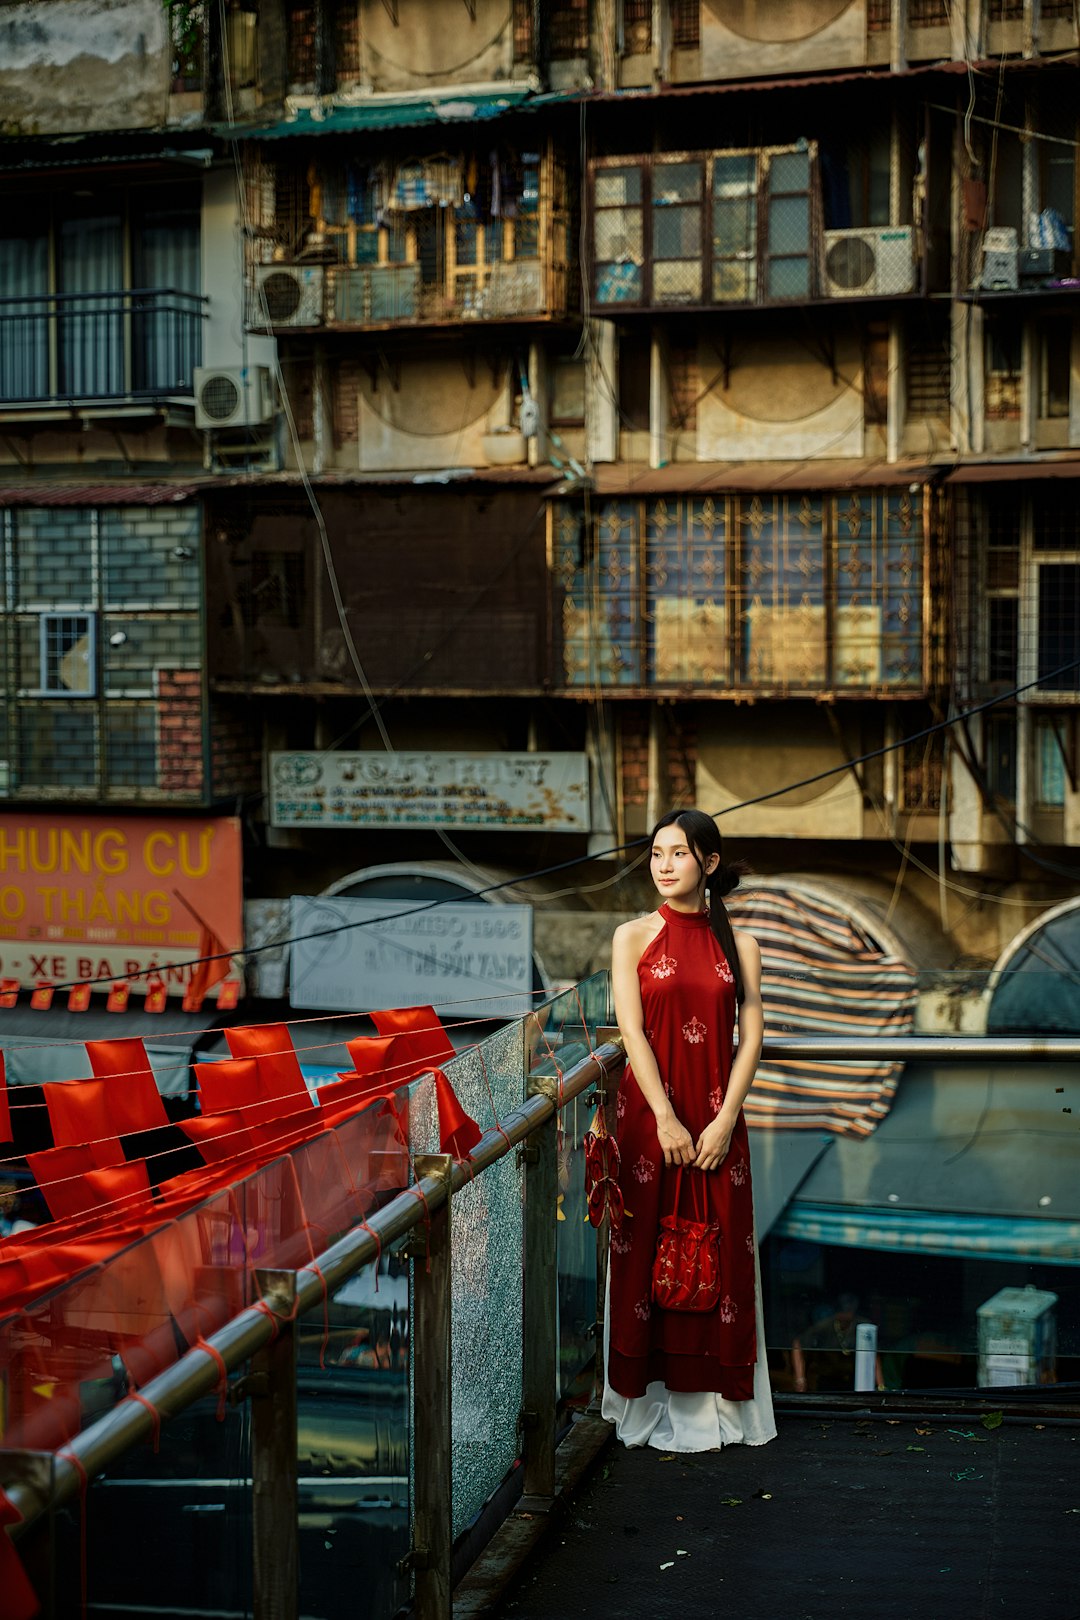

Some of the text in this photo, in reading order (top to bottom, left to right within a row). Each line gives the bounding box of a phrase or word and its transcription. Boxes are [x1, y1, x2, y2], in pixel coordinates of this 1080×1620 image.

[144, 825, 216, 879] CƯ
[37, 876, 172, 926] THẮNG
[29, 955, 67, 979] XE
[78, 958, 113, 980] BA
